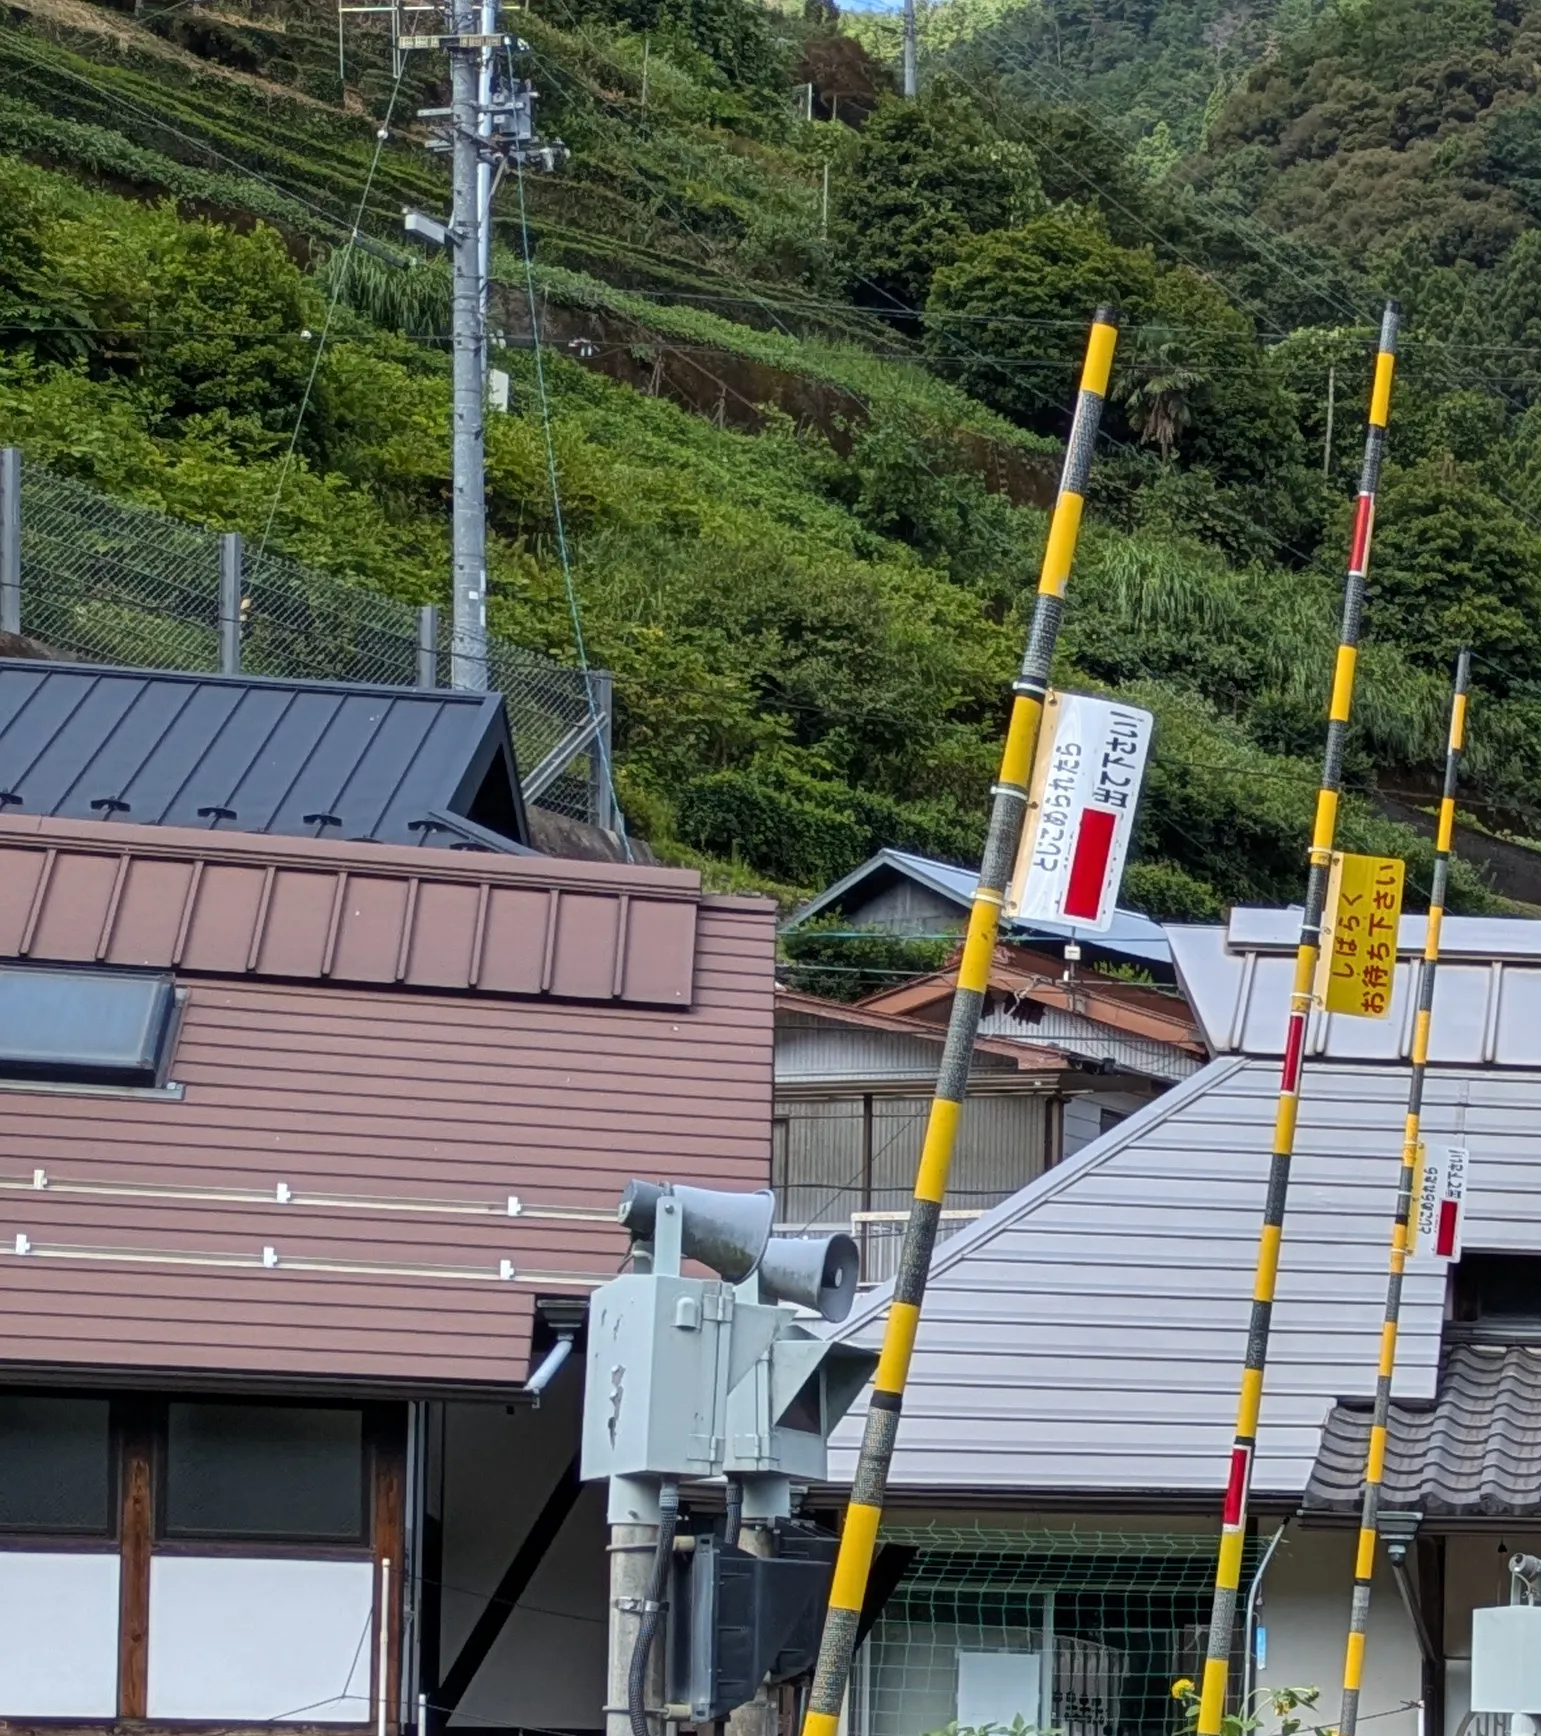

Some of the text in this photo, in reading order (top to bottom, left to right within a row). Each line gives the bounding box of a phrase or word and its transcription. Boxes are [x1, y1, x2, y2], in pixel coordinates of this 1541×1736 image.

[1033, 743, 1082, 872] とじこめられたら
[1331, 892, 1365, 979] しばらく
[1360, 864, 1397, 1014] お待ち下さい
[1418, 1166, 1438, 1235] とじこめられたら
